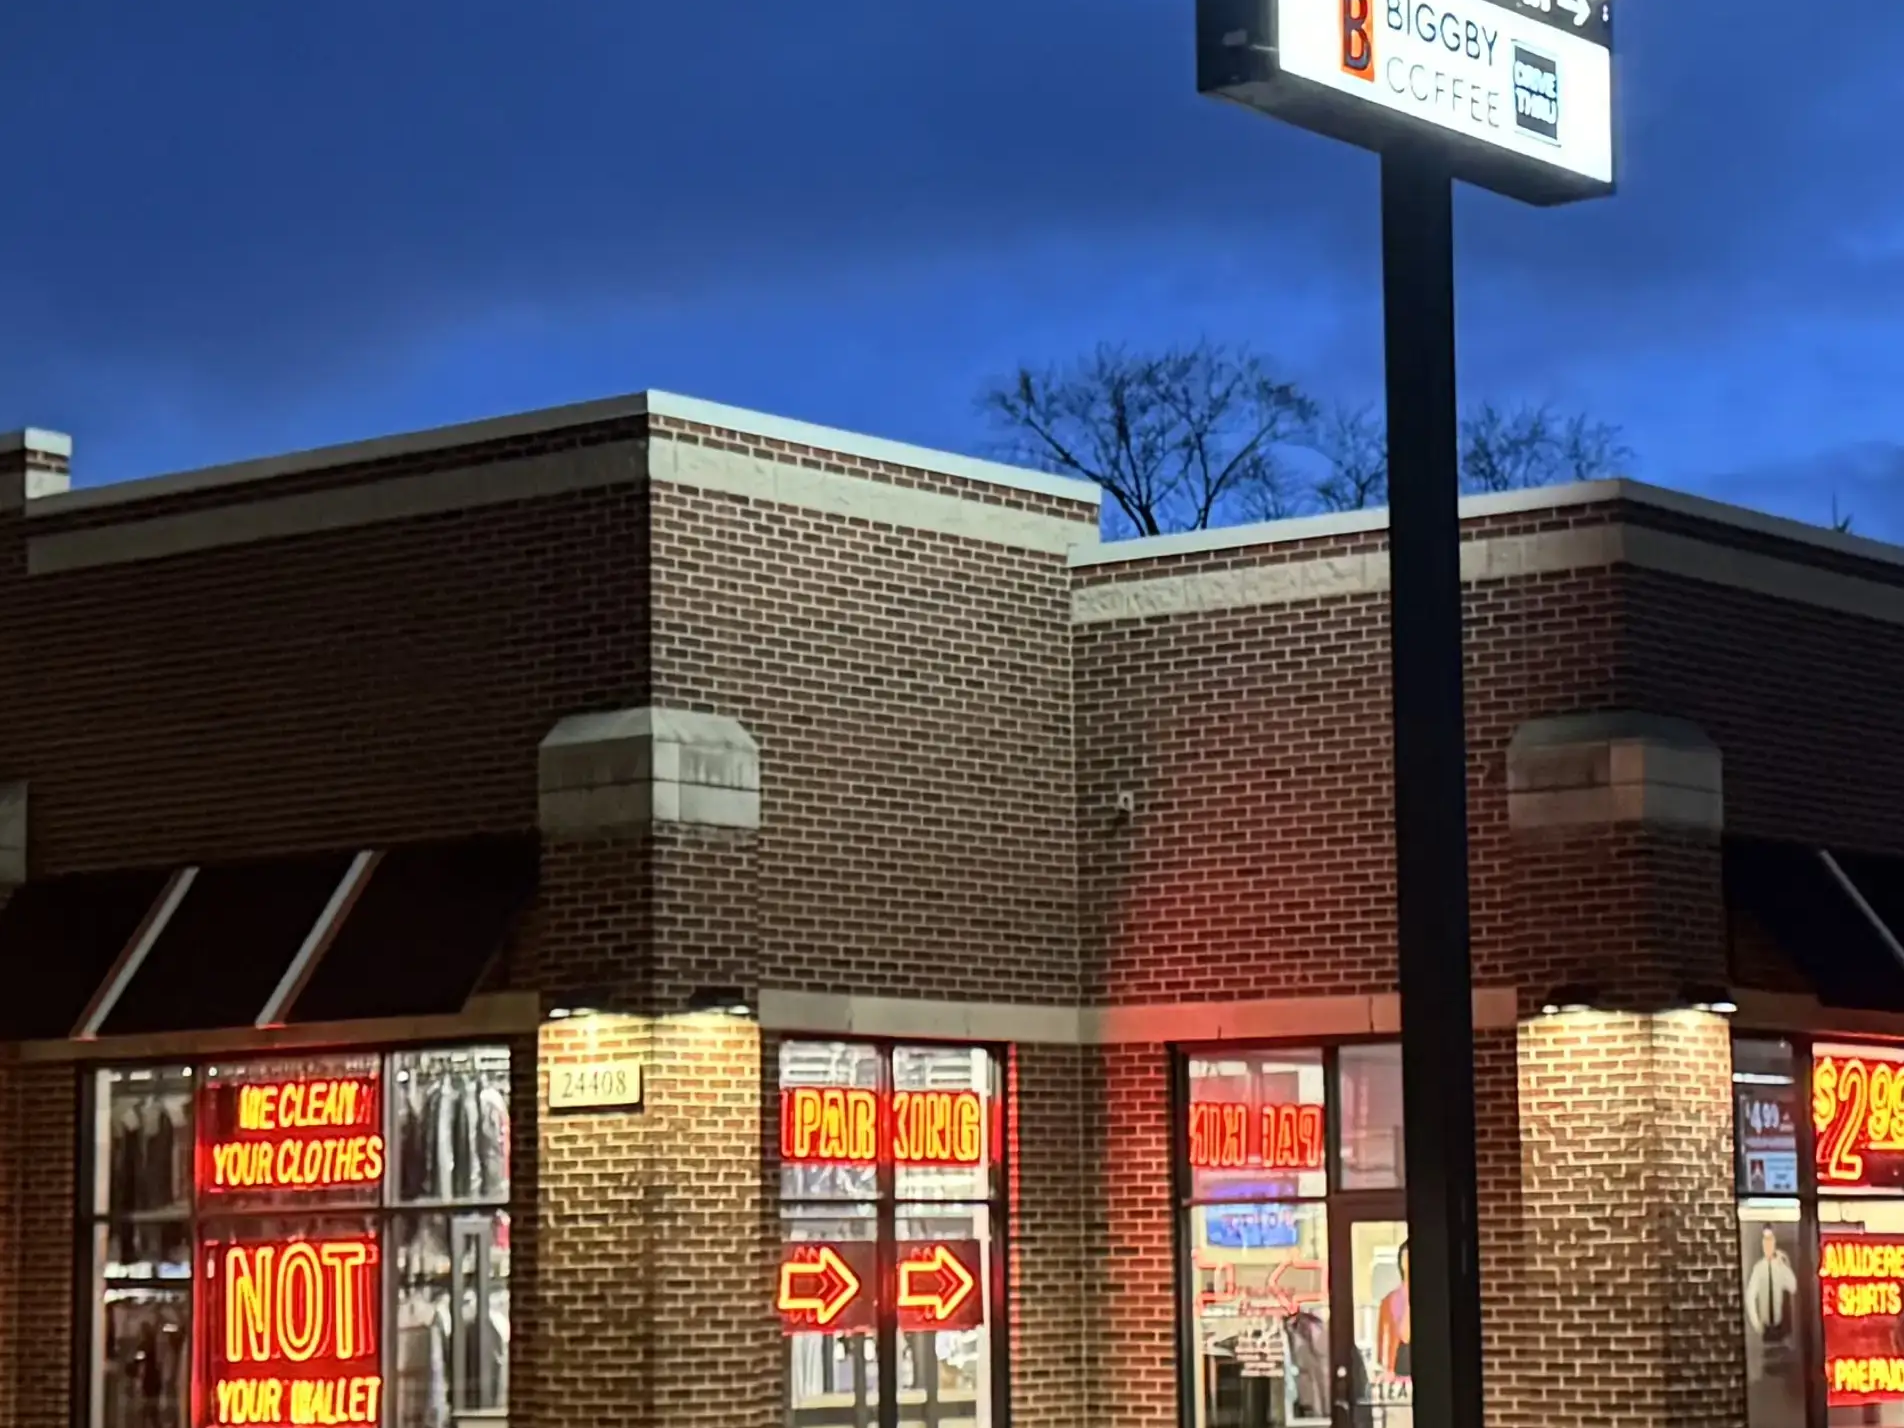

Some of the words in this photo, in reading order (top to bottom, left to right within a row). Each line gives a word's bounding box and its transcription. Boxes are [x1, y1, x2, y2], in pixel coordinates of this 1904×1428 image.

[1386, 56, 1500, 128] COFFEE
[278, 1080, 359, 1128] CLEAN
[561, 1069, 628, 1099] 24408
[212, 1139, 274, 1186] YOUR
[276, 1134, 384, 1184] CLOTHES
[226, 1242, 366, 1362] NOT
[1837, 1281, 1903, 1317] SHIRTS
[216, 1377, 283, 1424] YOUR
[290, 1376, 382, 1425] WALLET
